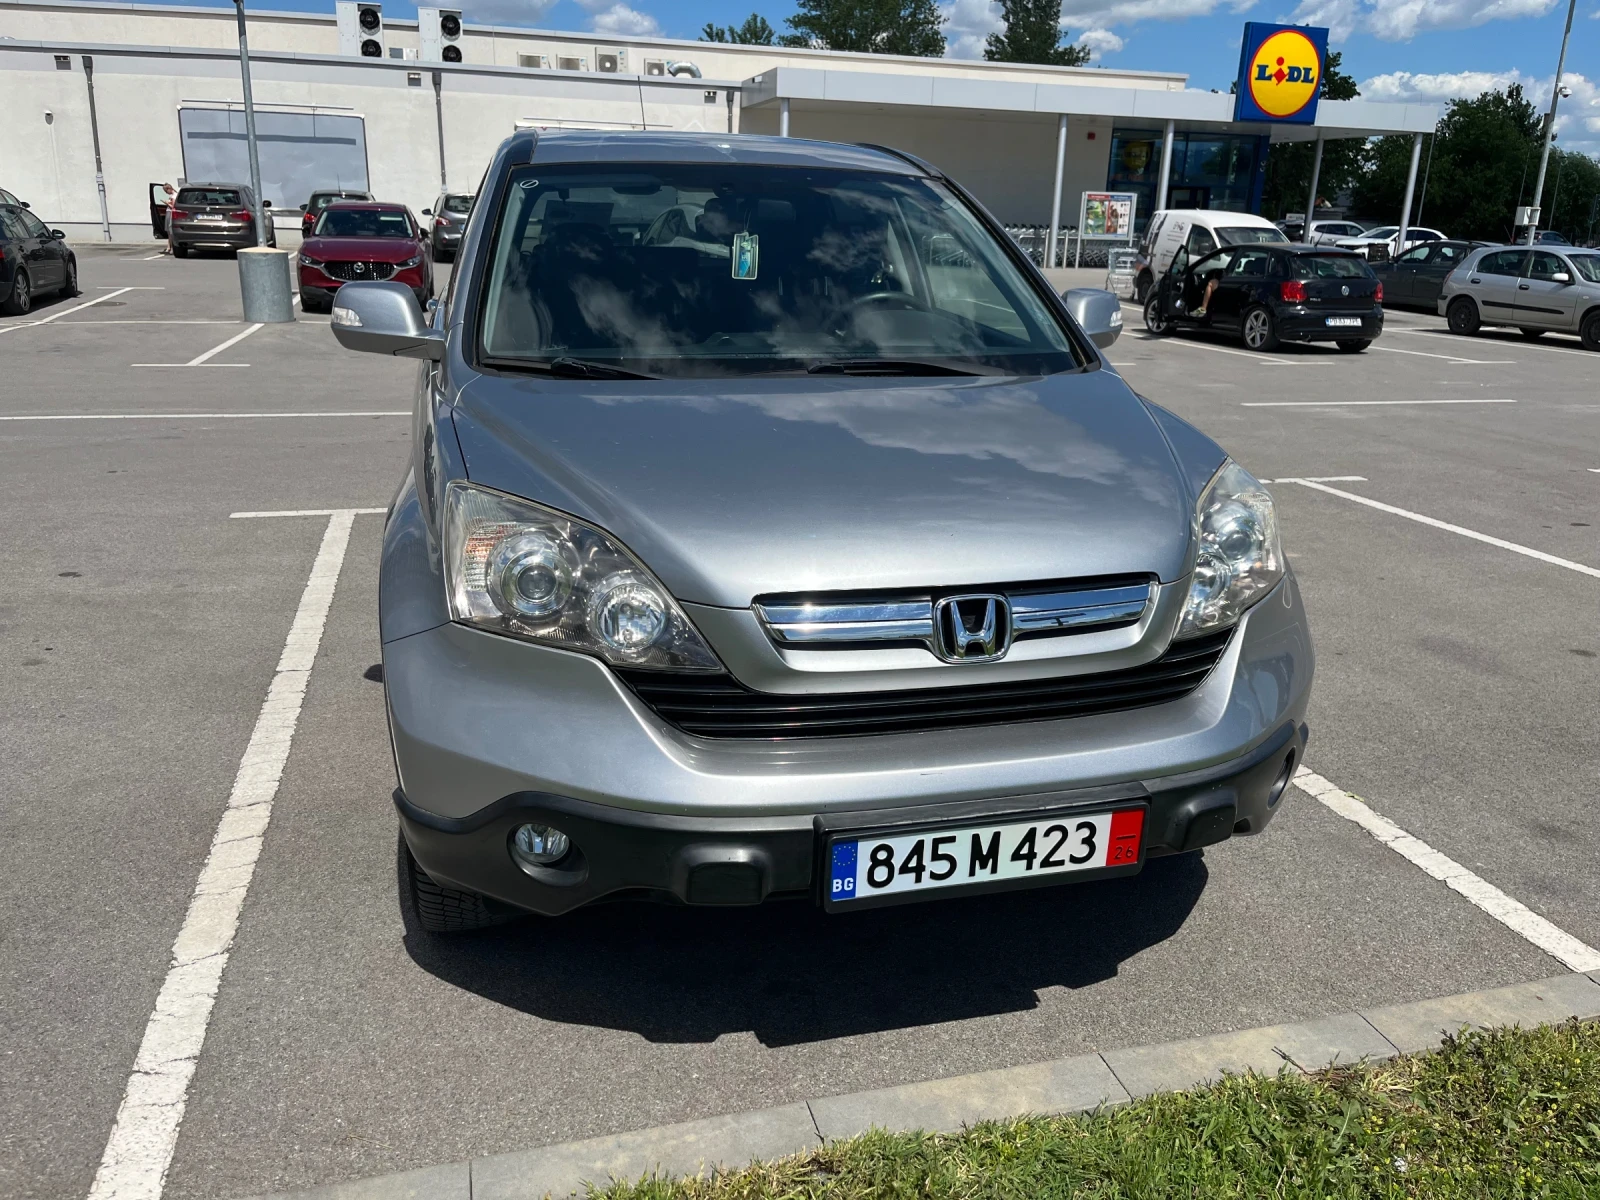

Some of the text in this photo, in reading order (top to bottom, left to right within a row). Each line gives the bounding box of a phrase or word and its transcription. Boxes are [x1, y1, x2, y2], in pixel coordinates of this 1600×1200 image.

[867, 821, 1097, 888] 845 M 423
[1113, 845, 1134, 860] 26
[832, 877, 854, 893] BG
